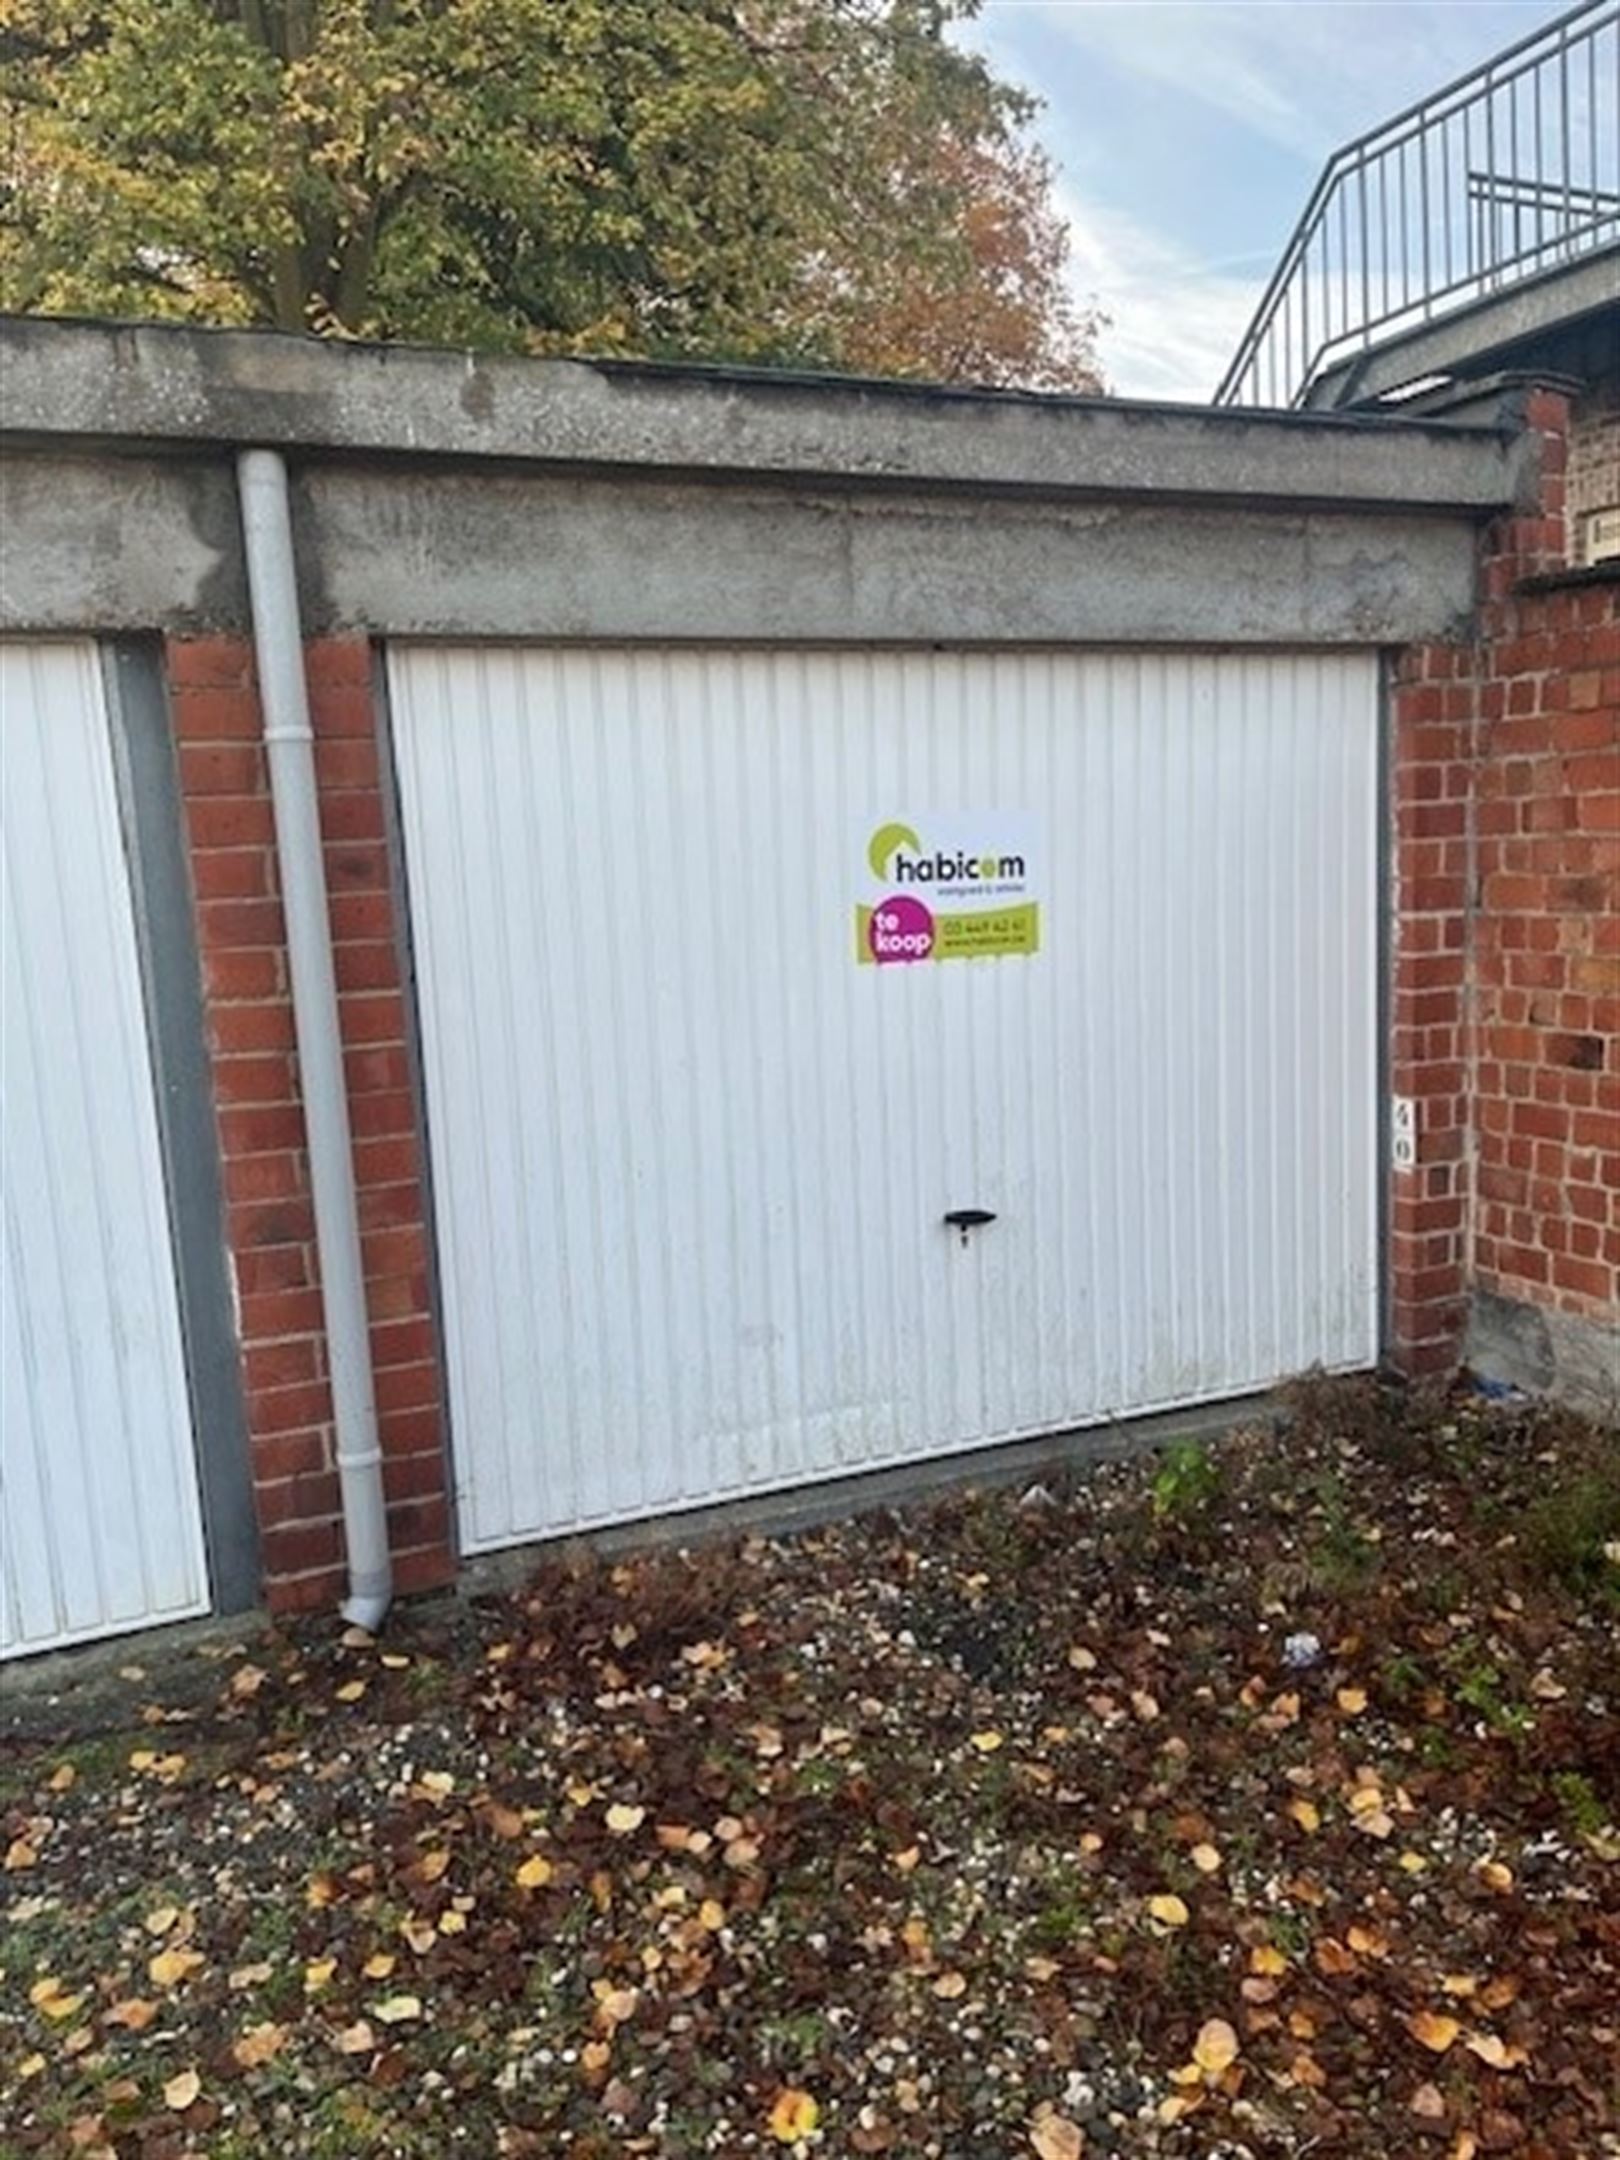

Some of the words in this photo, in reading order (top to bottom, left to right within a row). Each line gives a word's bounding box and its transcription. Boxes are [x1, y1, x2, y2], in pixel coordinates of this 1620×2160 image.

[896, 852, 1025, 882] habicom
[875, 912, 900, 931] te
[876, 931, 932, 956] koop
